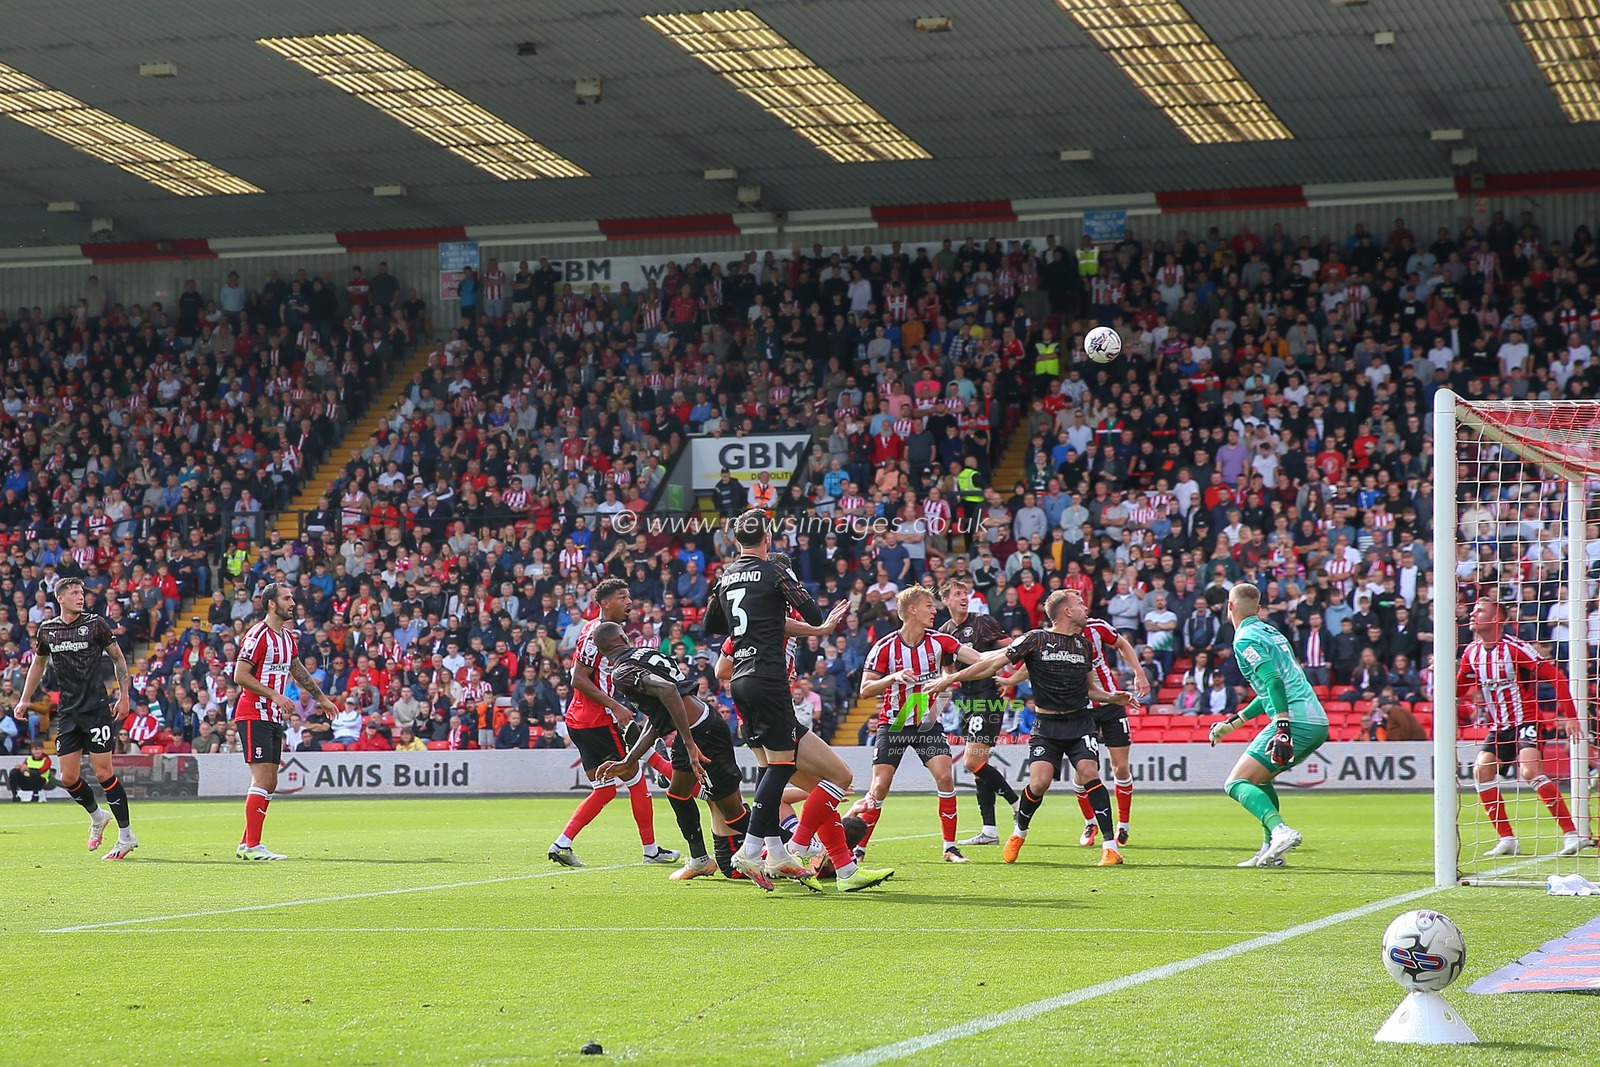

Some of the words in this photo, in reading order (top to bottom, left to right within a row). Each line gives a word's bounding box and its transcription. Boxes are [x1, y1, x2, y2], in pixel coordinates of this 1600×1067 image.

[718, 441, 804, 470] GBM
[721, 570, 762, 588] HUSBAND
[726, 587, 748, 637] 3
[49, 641, 89, 653] LeoVegas
[1041, 650, 1085, 664] LeoVegas
[968, 715, 984, 732] 18
[1519, 725, 1538, 739] 16
[90, 725, 111, 742] 20
[1082, 734, 1099, 751] 16
[314, 764, 382, 788] AMS
[394, 762, 469, 787] Build
[1338, 755, 1417, 781] AMS
